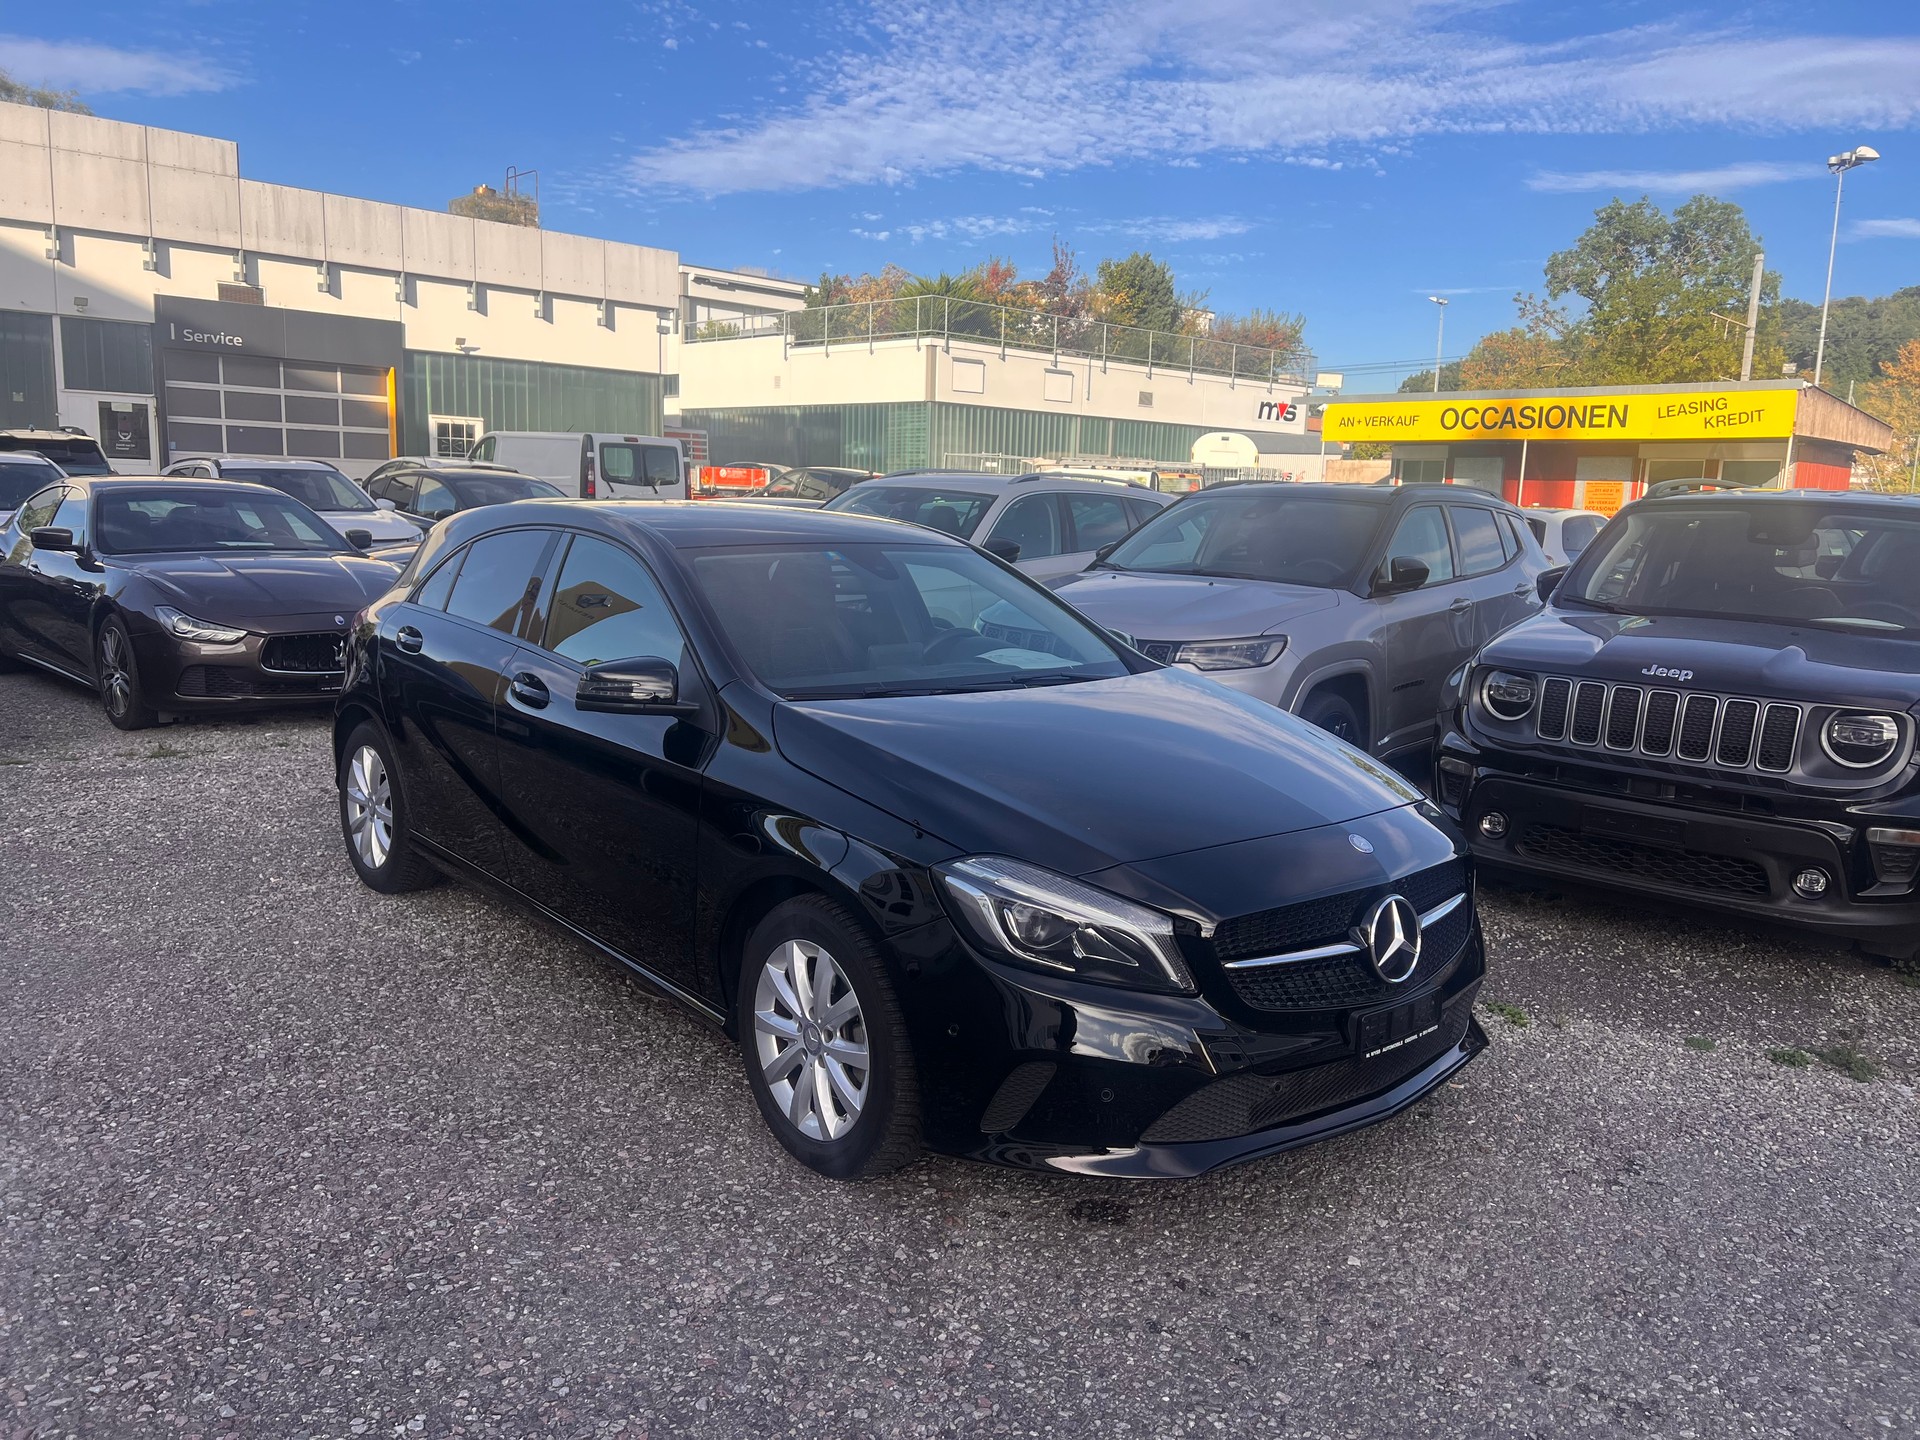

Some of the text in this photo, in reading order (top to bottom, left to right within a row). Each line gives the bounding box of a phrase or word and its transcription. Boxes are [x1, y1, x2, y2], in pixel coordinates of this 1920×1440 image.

[183, 328, 243, 347] Service
[1440, 404, 1629, 431] OCCASIONEN
[1658, 397, 1728, 419] LEASING
[1704, 408, 1765, 430] KREDIT
[1641, 664, 1694, 681] Jeep
